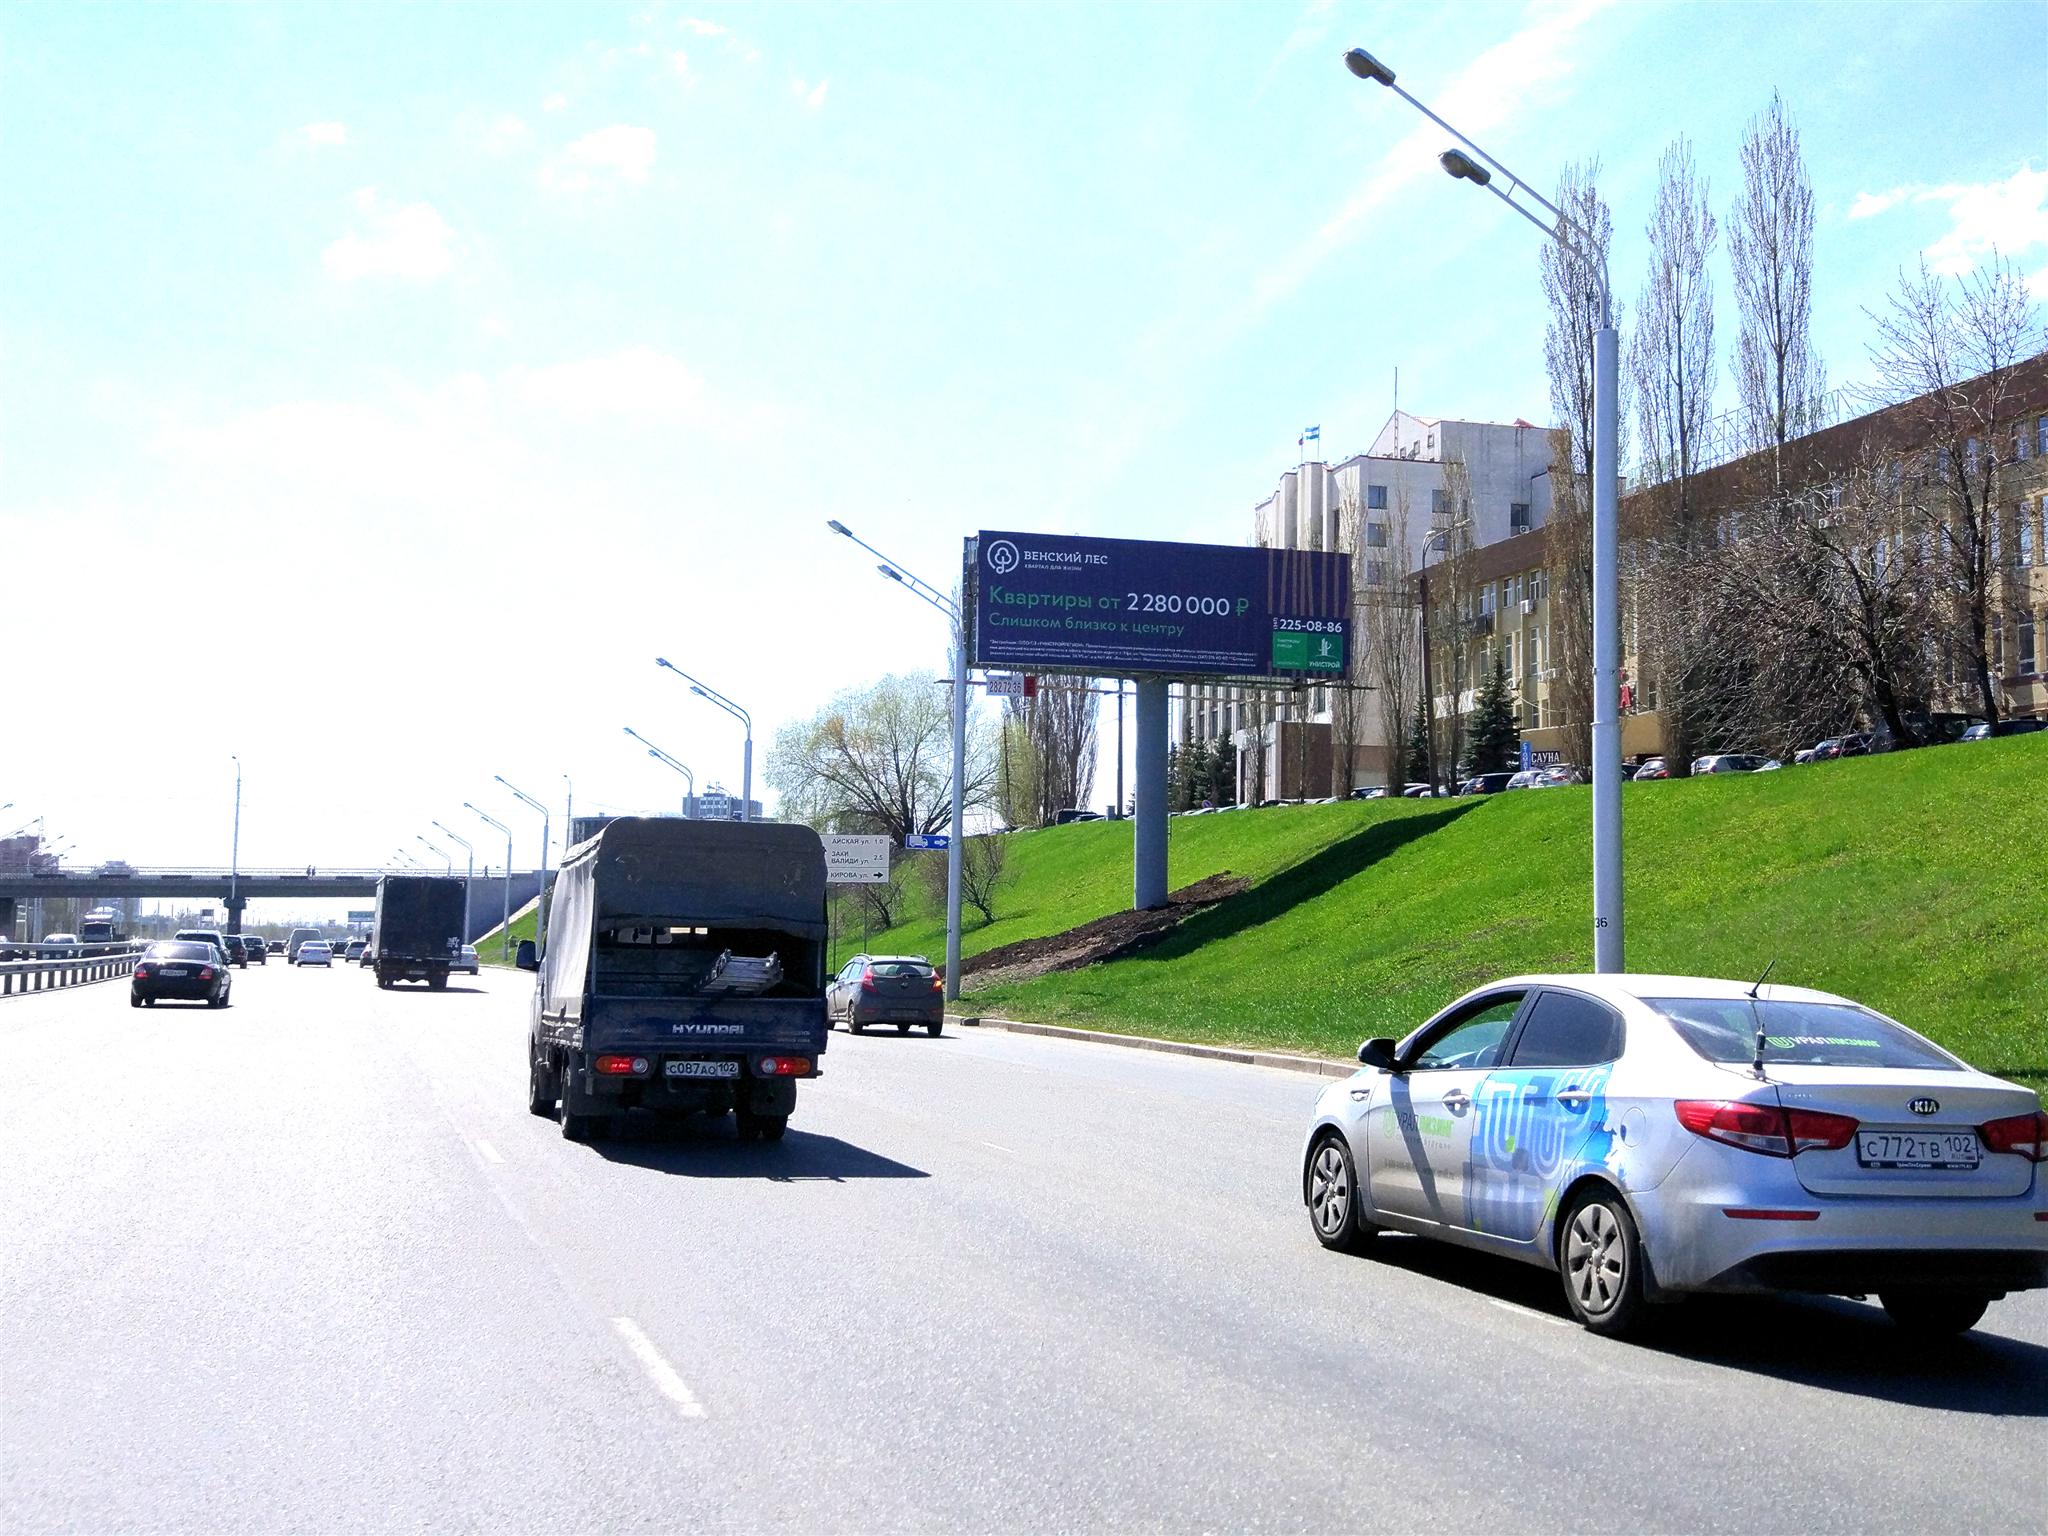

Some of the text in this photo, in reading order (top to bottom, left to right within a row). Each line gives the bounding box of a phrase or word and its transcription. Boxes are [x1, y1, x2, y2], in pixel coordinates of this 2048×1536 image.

[1023, 551, 1108, 565] ВЕНСКИЙ ЛЕС
[989, 586, 1092, 611] Квартиры
[1098, 597, 1120, 609] от
[989, 612, 1184, 636] Слишком близко к центру
[1280, 619, 1342, 632] 225-08-86
[1531, 752, 1560, 763] САУНА
[672, 1024, 744, 1035] HYUNDAI
[718, 1062, 737, 1072] 102
[1914, 1101, 1938, 1113] KIA
[1867, 1136, 1971, 1158] С772ТВ 102
